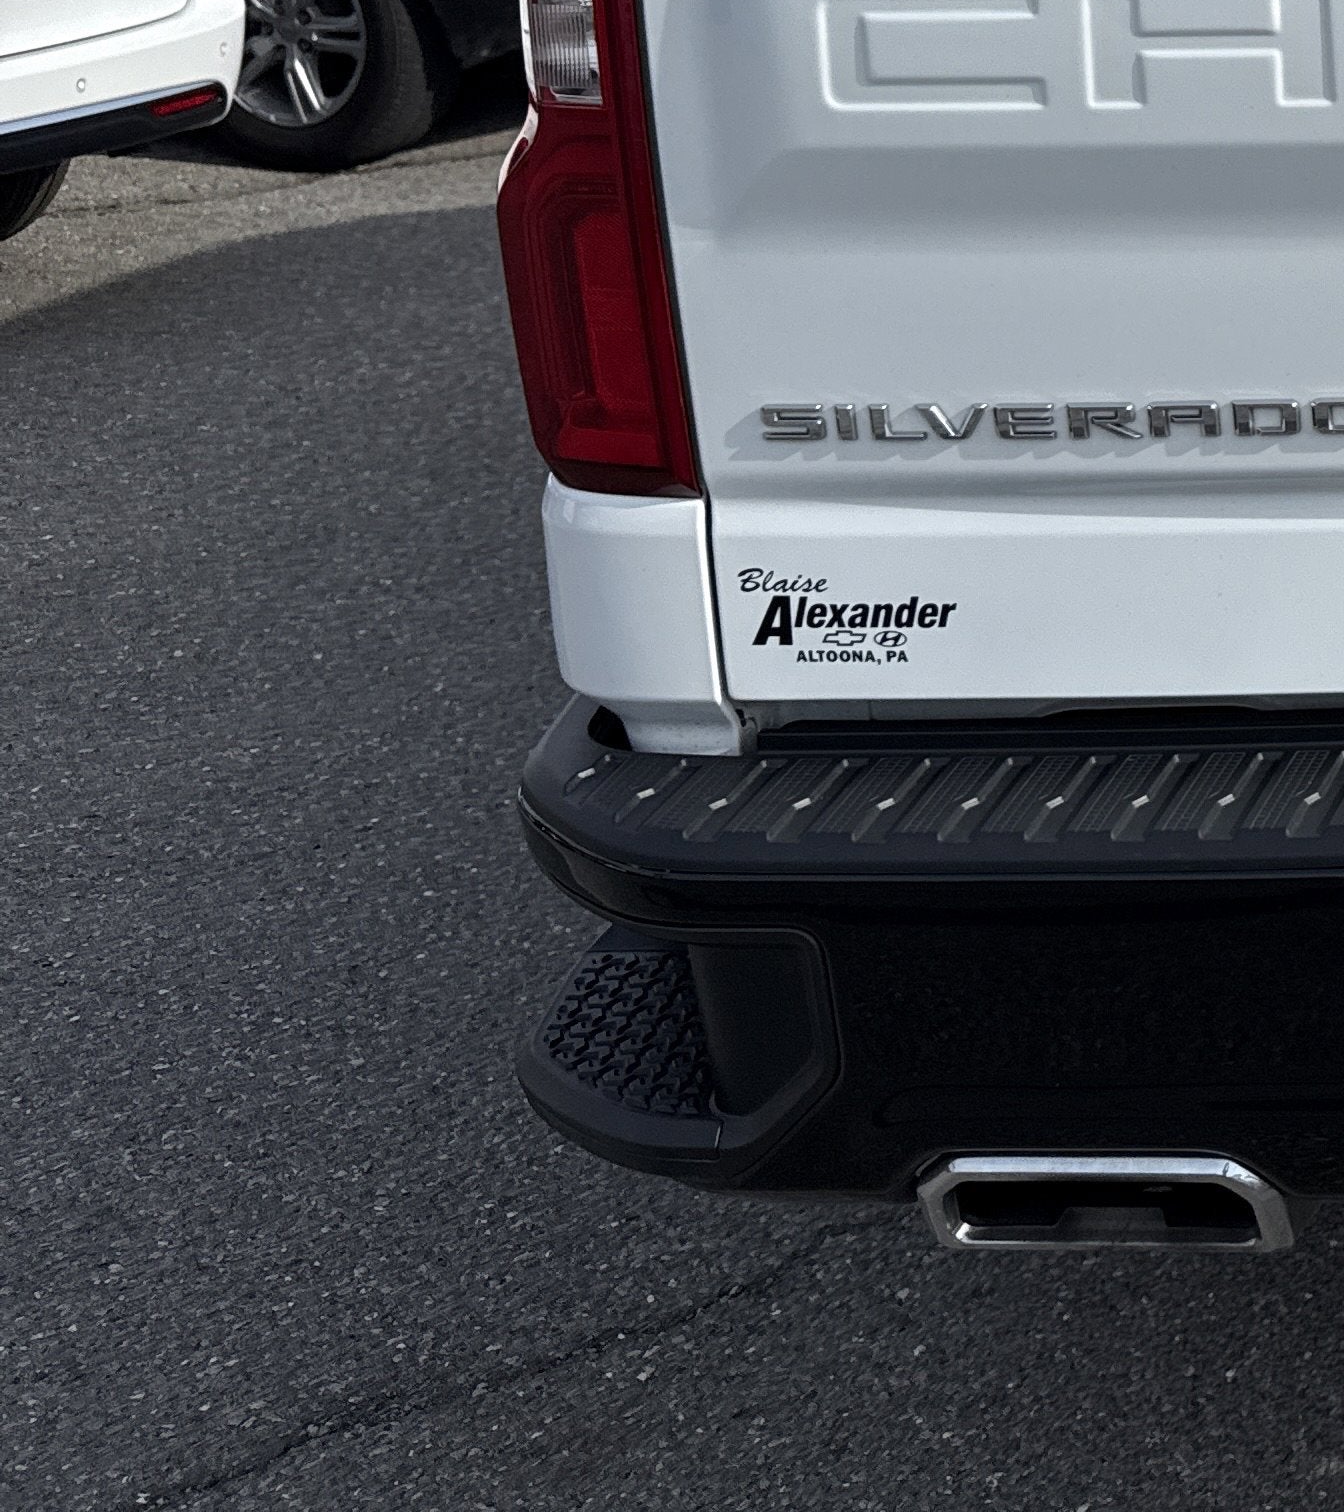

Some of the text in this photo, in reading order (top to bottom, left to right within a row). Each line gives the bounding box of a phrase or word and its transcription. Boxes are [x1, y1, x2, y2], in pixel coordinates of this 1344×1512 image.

[737, 568, 829, 593] Blaise
[752, 595, 958, 646] Alexander
[796, 650, 909, 666] ALTOONA, PA
